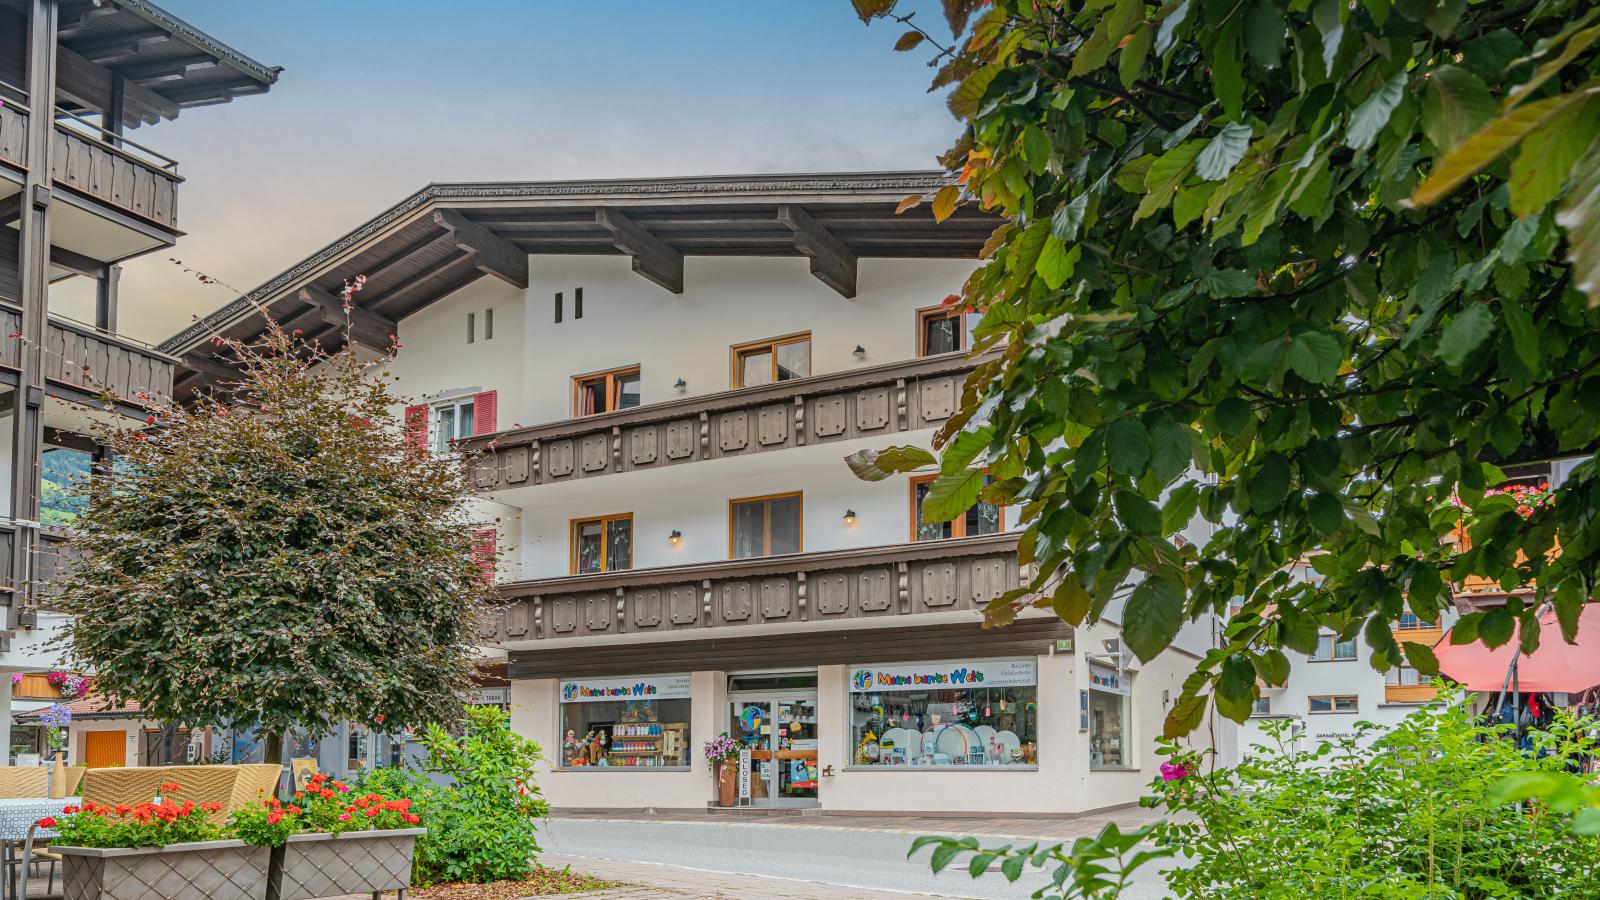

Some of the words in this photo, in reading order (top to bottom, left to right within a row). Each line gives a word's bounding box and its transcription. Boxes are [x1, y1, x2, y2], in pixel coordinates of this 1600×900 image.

[877, 672, 912, 685] Meine
[914, 672, 948, 684] bunte
[950, 667, 984, 684] Welt
[580, 686, 605, 697] Meine
[632, 682, 657, 696] Welt
